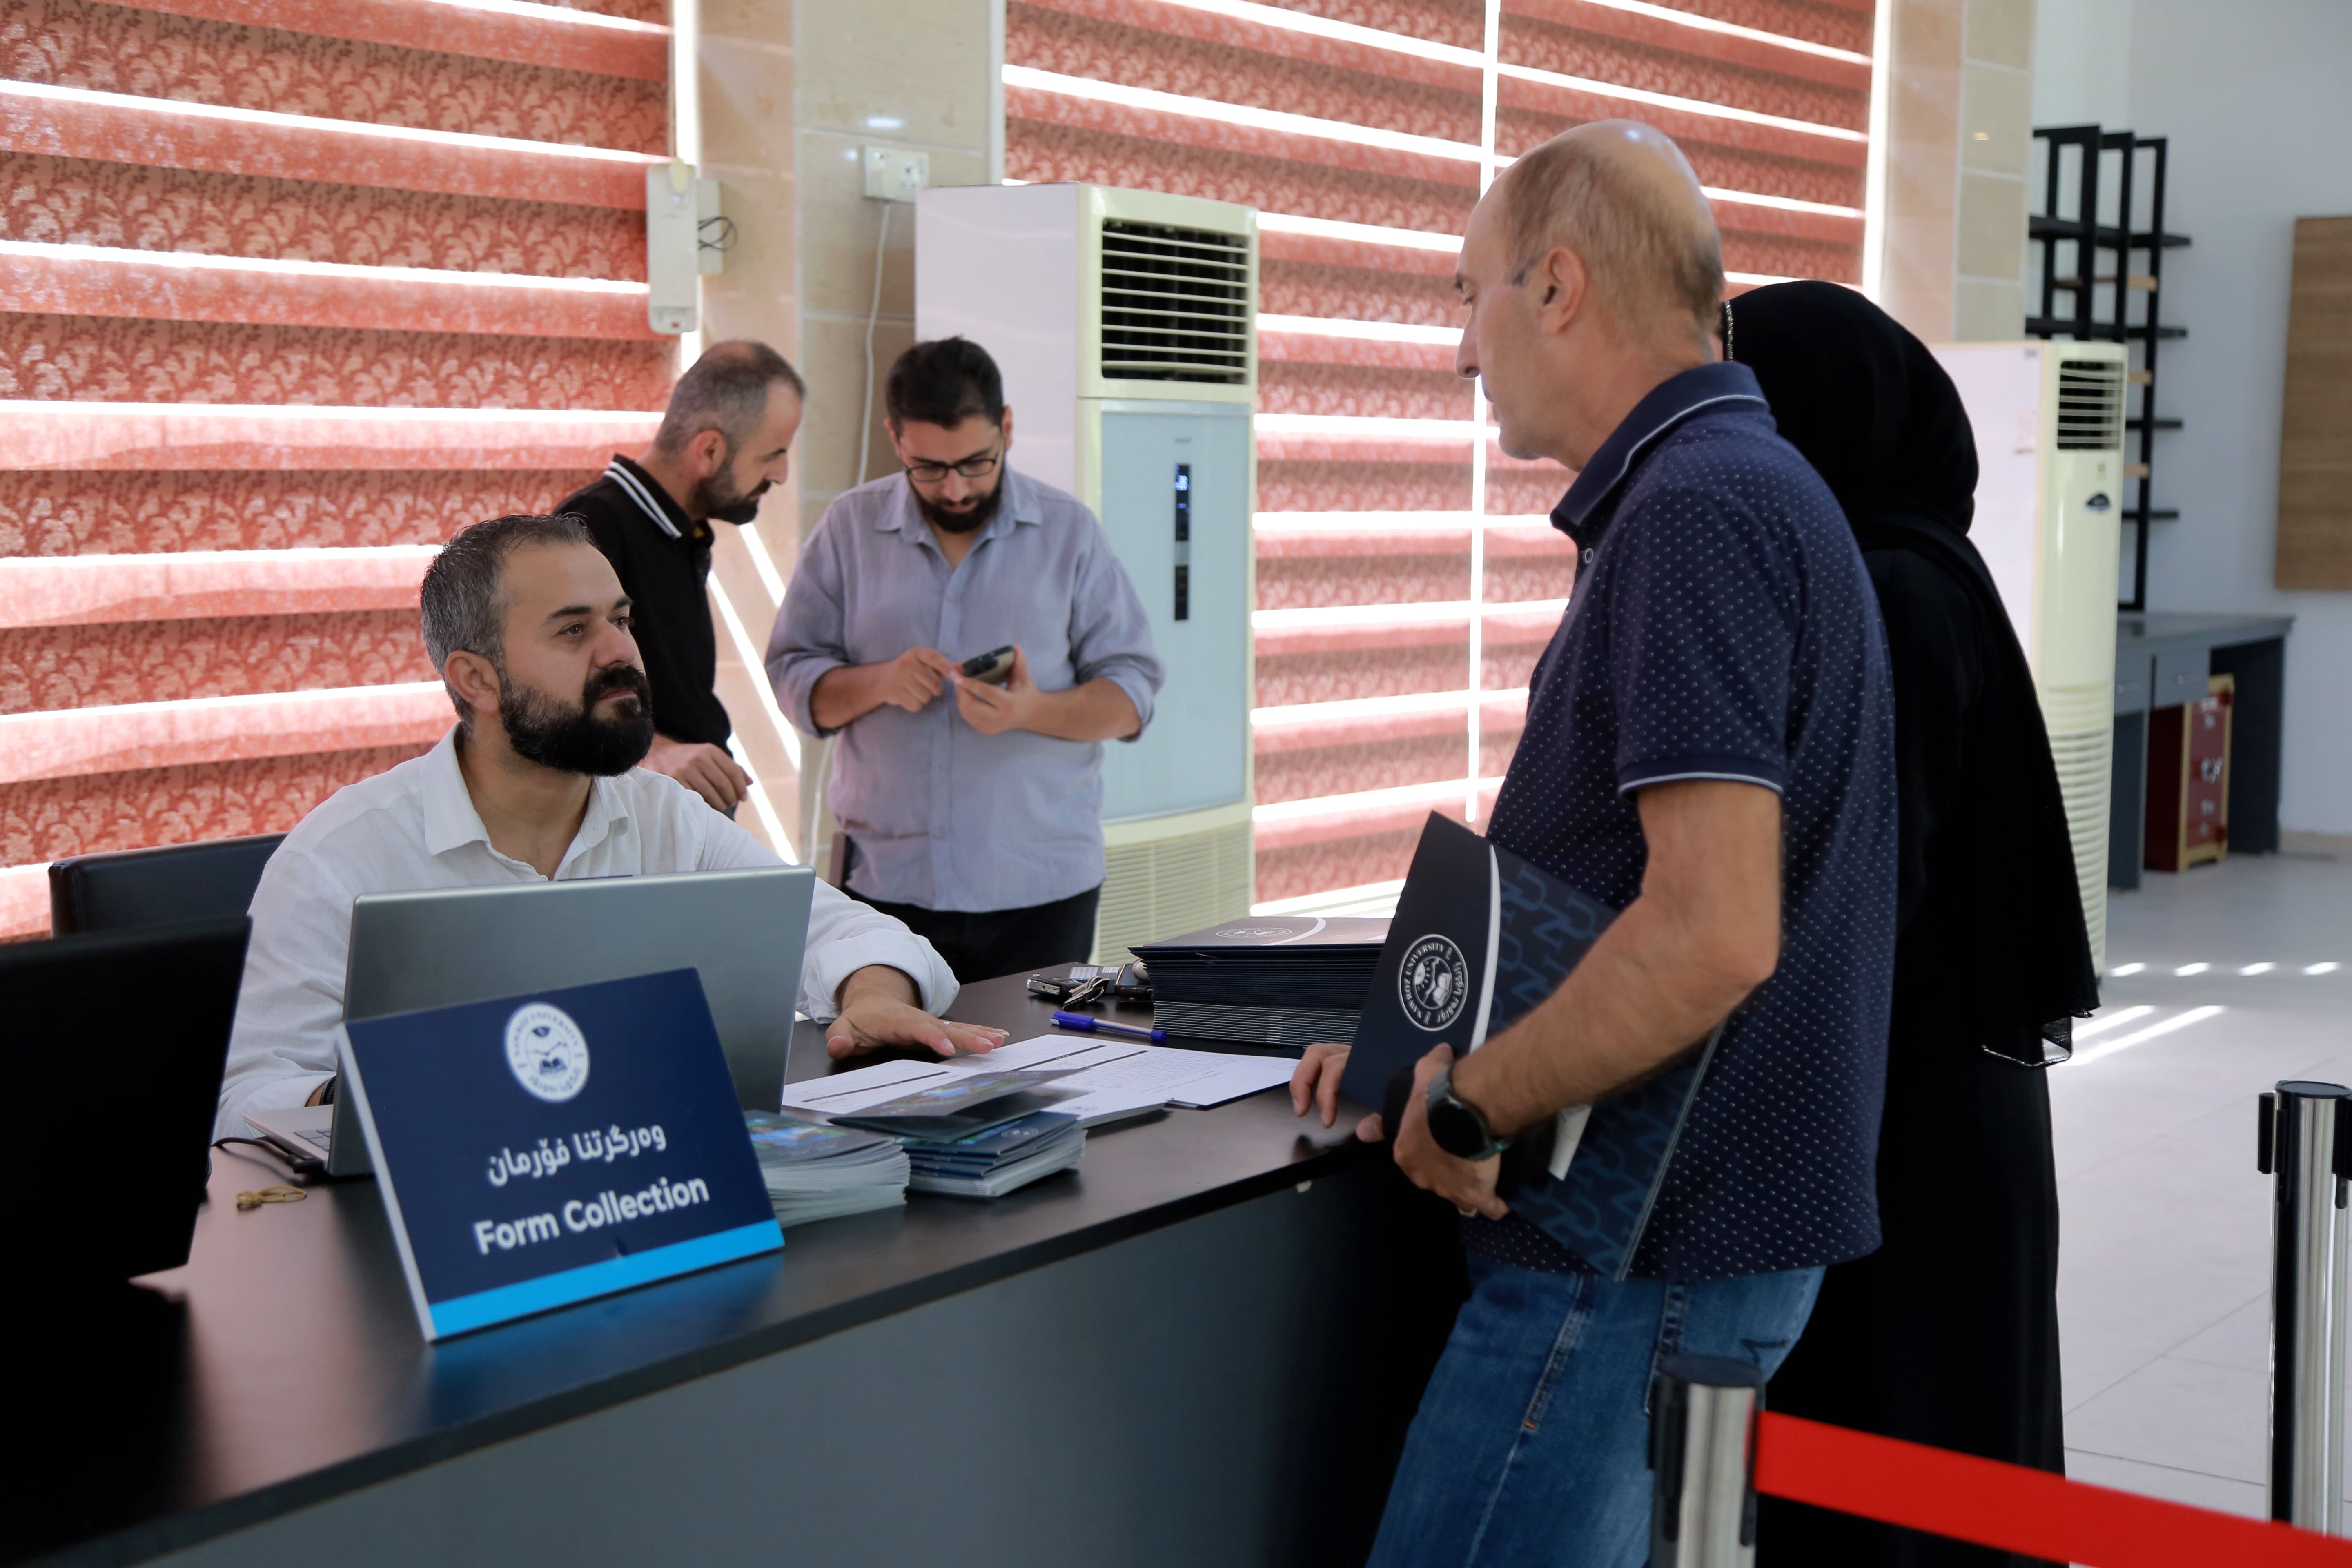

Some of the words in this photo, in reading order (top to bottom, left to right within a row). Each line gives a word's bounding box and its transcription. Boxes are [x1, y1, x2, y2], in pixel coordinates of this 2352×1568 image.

[1404, 942, 1444, 976] UNIVERSITY
[1404, 978, 1421, 1019] NAWROZ
[475, 1213, 560, 1254] Form
[564, 1177, 710, 1232] Collection
